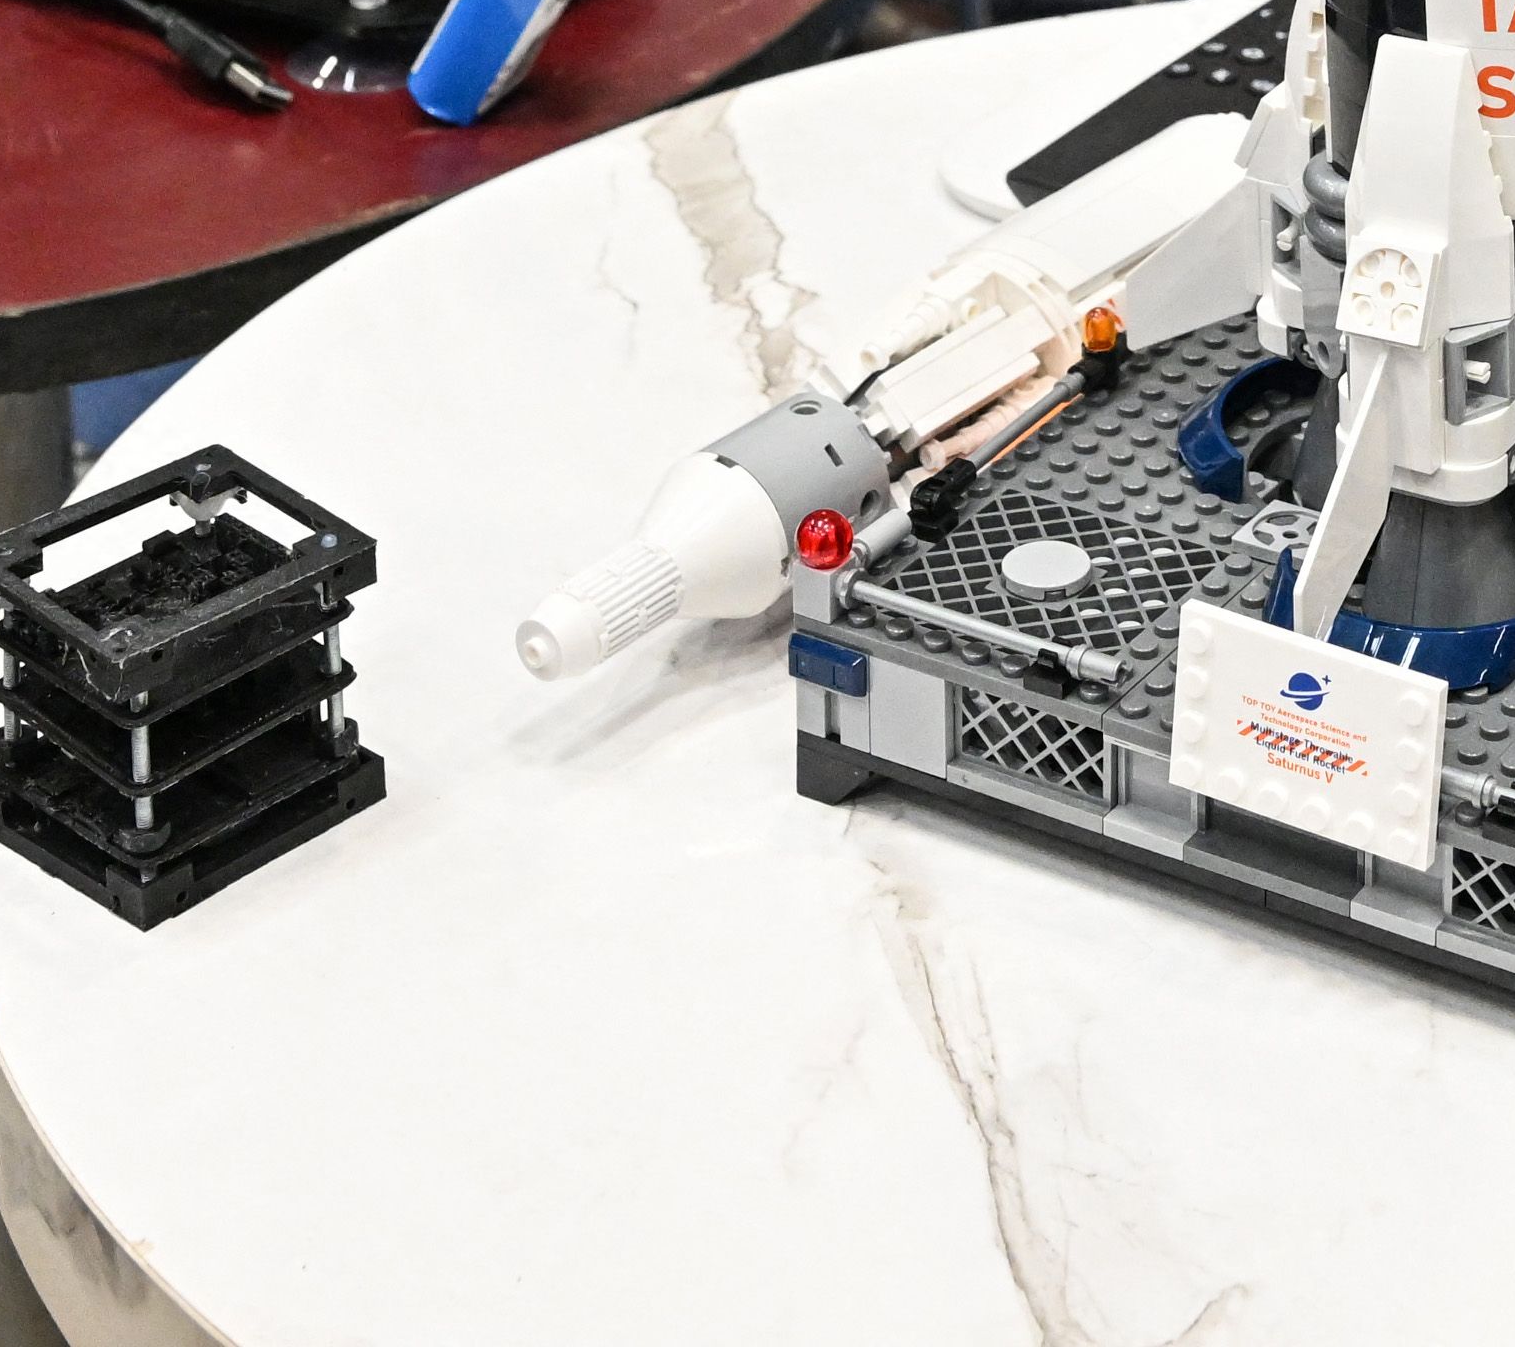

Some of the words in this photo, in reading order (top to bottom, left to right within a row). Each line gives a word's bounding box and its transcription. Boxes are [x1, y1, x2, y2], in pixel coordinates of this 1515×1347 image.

[1242, 695, 1258, 706] TOP
[1260, 702, 1276, 712] TOY
[1277, 708, 1317, 726] Aerospace
[1320, 722, 1350, 737] Science
[1353, 733, 1367, 742] and
[1261, 713, 1302, 734] Technology
[1305, 728, 1350, 748] Corporation
[1250, 721, 1301, 746] Multistage
[1305, 739, 1353, 763] Throwable
[1256, 737, 1285, 754] Liquid
[1289, 747, 1310, 761] Fuel
[1313, 755, 1345, 774] Rocket
[1267, 752, 1320, 780] Saturnus
[1325, 771, 1333, 783] V
